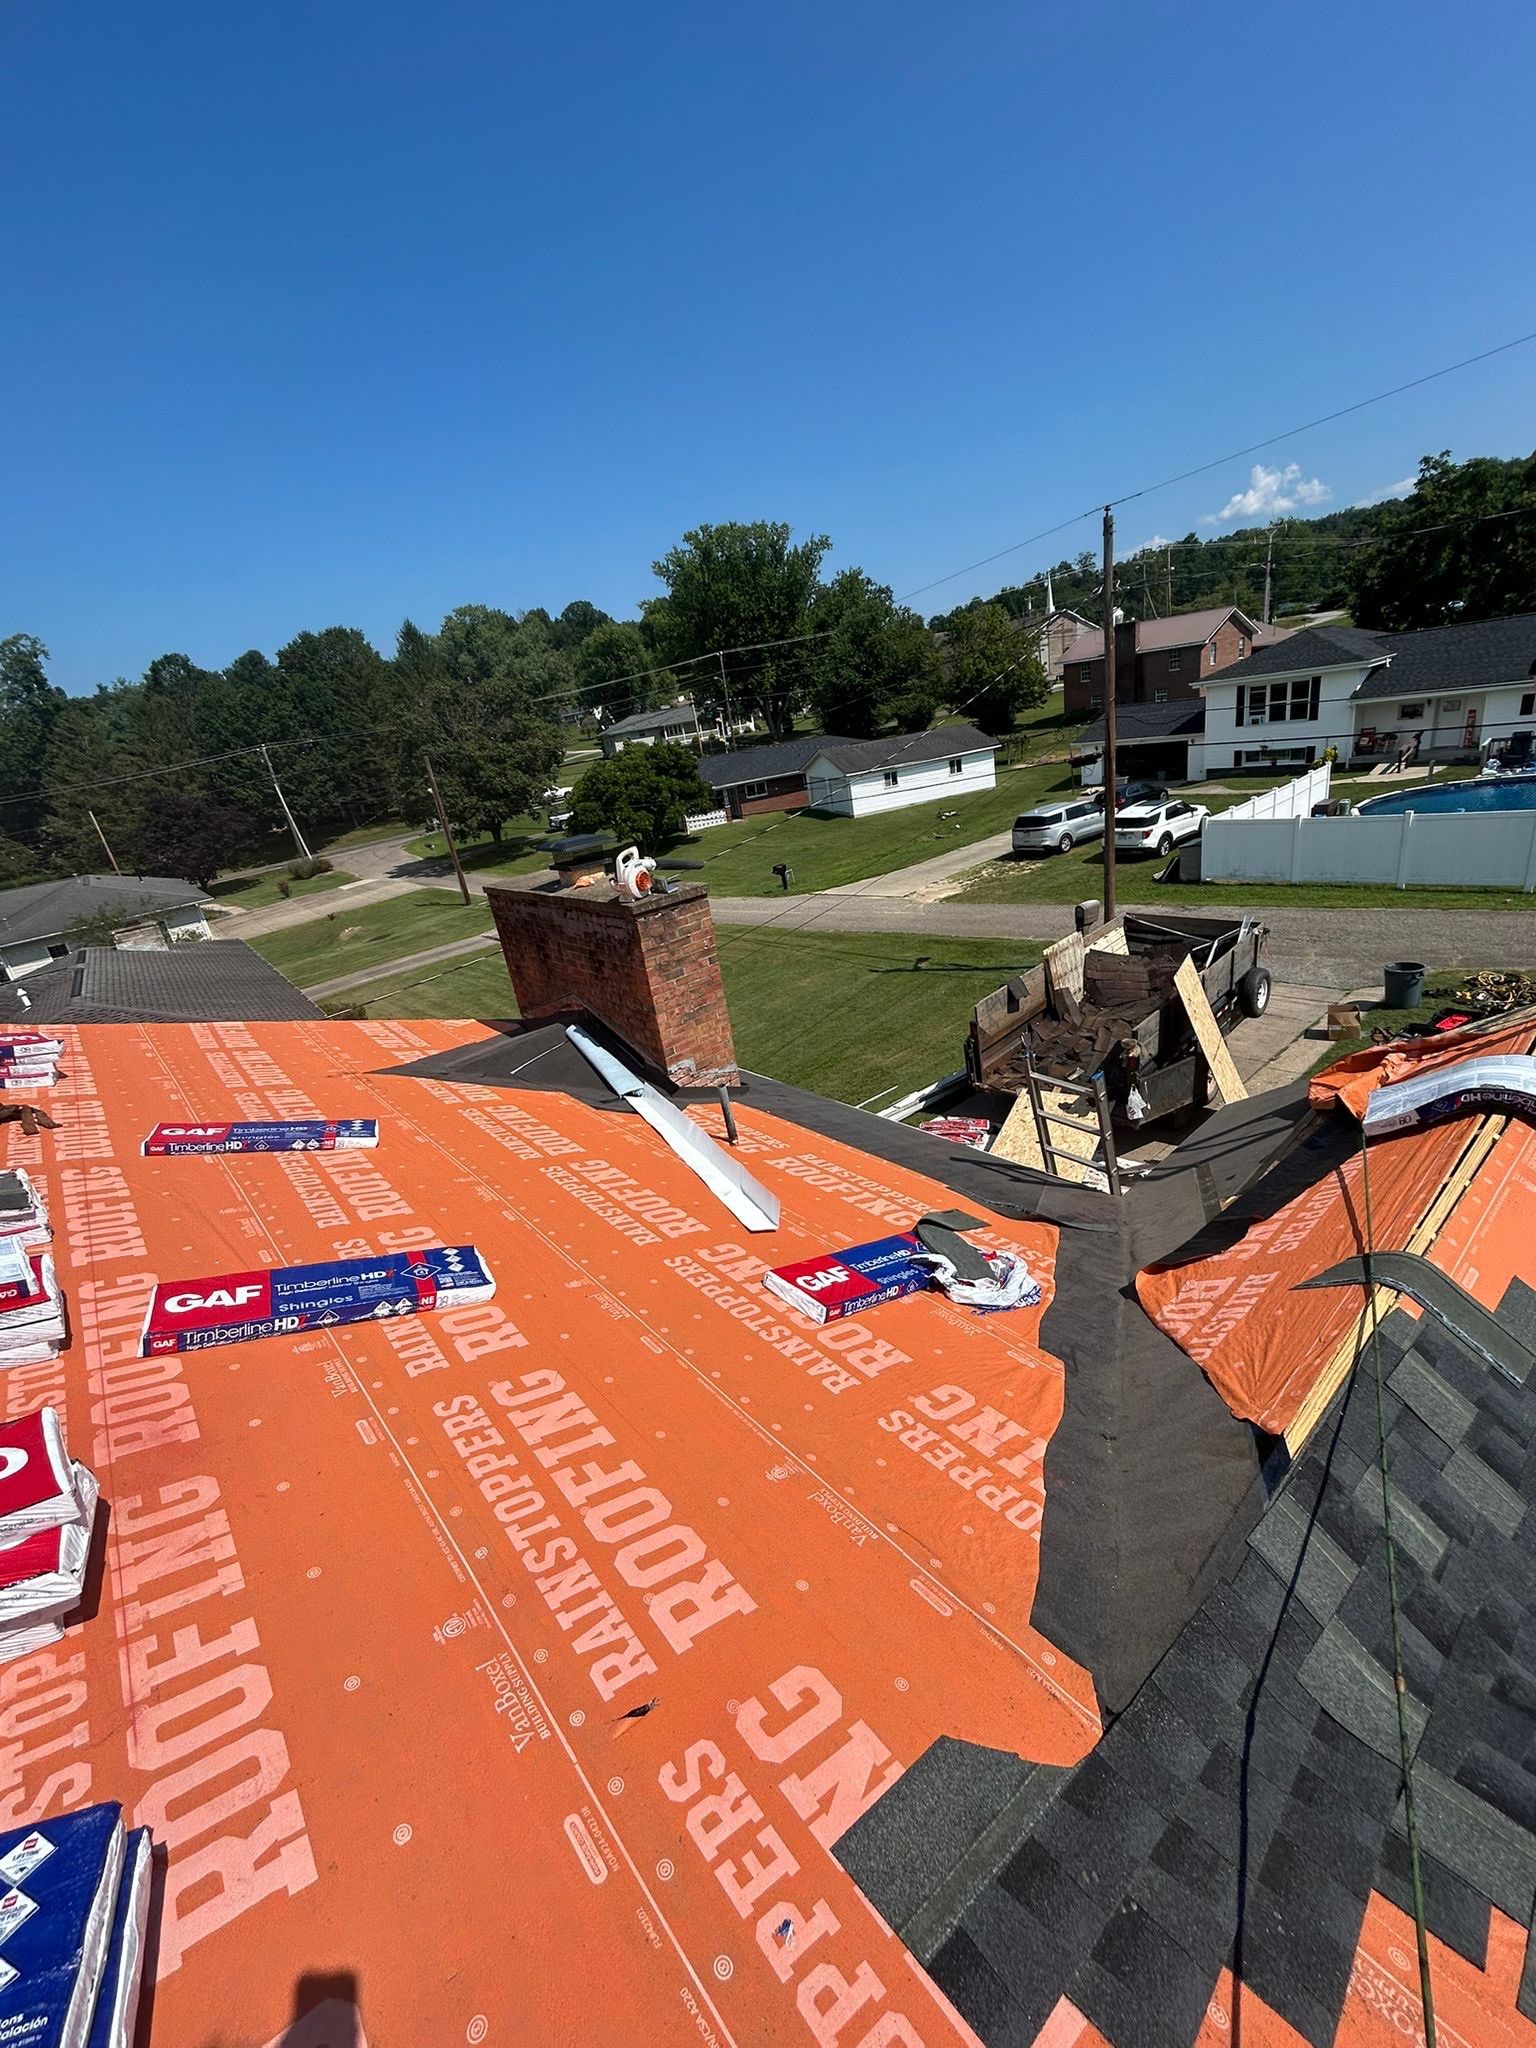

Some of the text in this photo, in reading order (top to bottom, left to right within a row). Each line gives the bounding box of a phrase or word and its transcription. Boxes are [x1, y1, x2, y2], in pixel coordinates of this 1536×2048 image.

[51, 1101, 115, 1162] ROOFING
[161, 1128, 226, 1136] GAF
[457, 1108, 543, 1160] RAINSTOPPERS
[484, 1104, 587, 1157] ROOFING
[60, 1166, 149, 1268] ROOFING
[538, 1165, 663, 1248] RAINSTOPPERS
[566, 1158, 712, 1239] ROOFING
[763, 1157, 920, 1227] ROOFING
[164, 1285, 264, 1314] GAF
[279, 1295, 354, 1312] Shingles
[795, 1265, 850, 1292] GAF
[152, 1338, 177, 1349] GAF
[664, 1256, 861, 1396] RAINSTOPPERS
[829, 1308, 841, 1316] GAF
[78, 1272, 201, 1468] ROOFING
[490, 1368, 760, 1656] ROOFING
[432, 1394, 659, 1702] RAINSTOPPERS
[474, 1657, 535, 1755] VanBoxel
[496, 1651, 552, 1741] BUILDING SUPPLY
[107, 1475, 319, 1985] ROOFING
[0, 2015, 49, 2040] alación
[679, 1986, 700, 2016] A220
